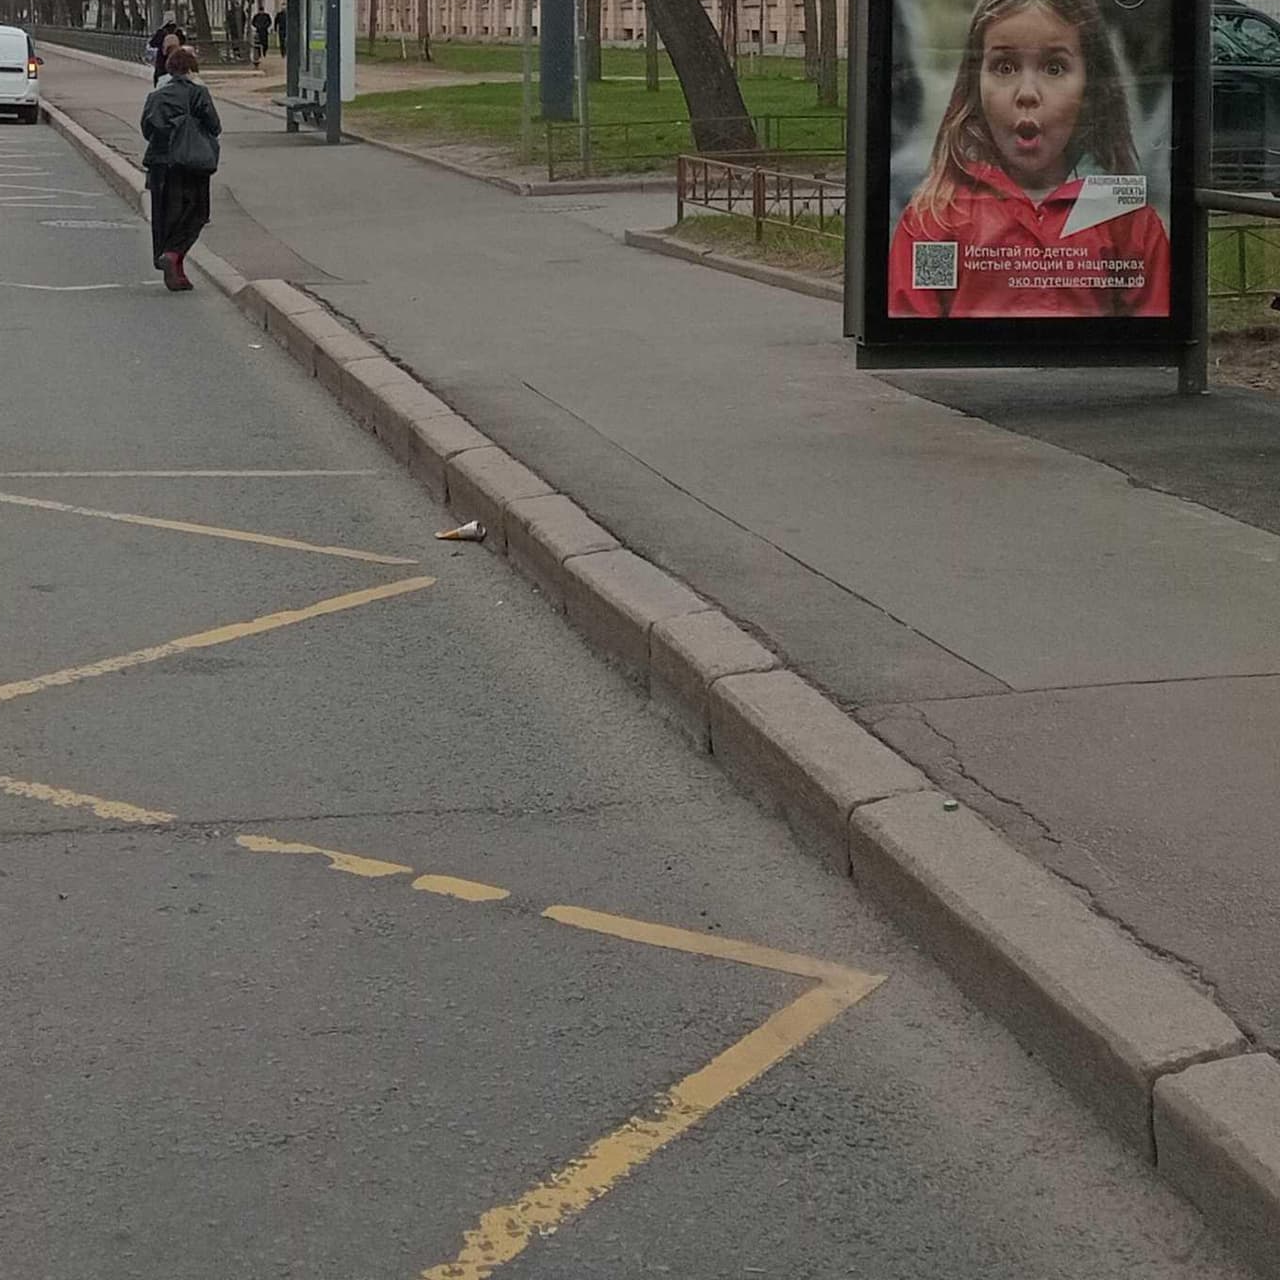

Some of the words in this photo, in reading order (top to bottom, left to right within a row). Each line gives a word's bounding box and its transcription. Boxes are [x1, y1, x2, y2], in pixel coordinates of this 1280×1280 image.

[964, 245, 1021, 258] Испытай
[1024, 247, 1088, 259] по-детски
[964, 260, 1012, 270] чистые
[1014, 260, 1064, 271] эмоции
[1066, 260, 1075, 270] в
[1077, 260, 1145, 272] нацпарках
[1008, 274, 1146, 288] эко.путешествуем.рф
